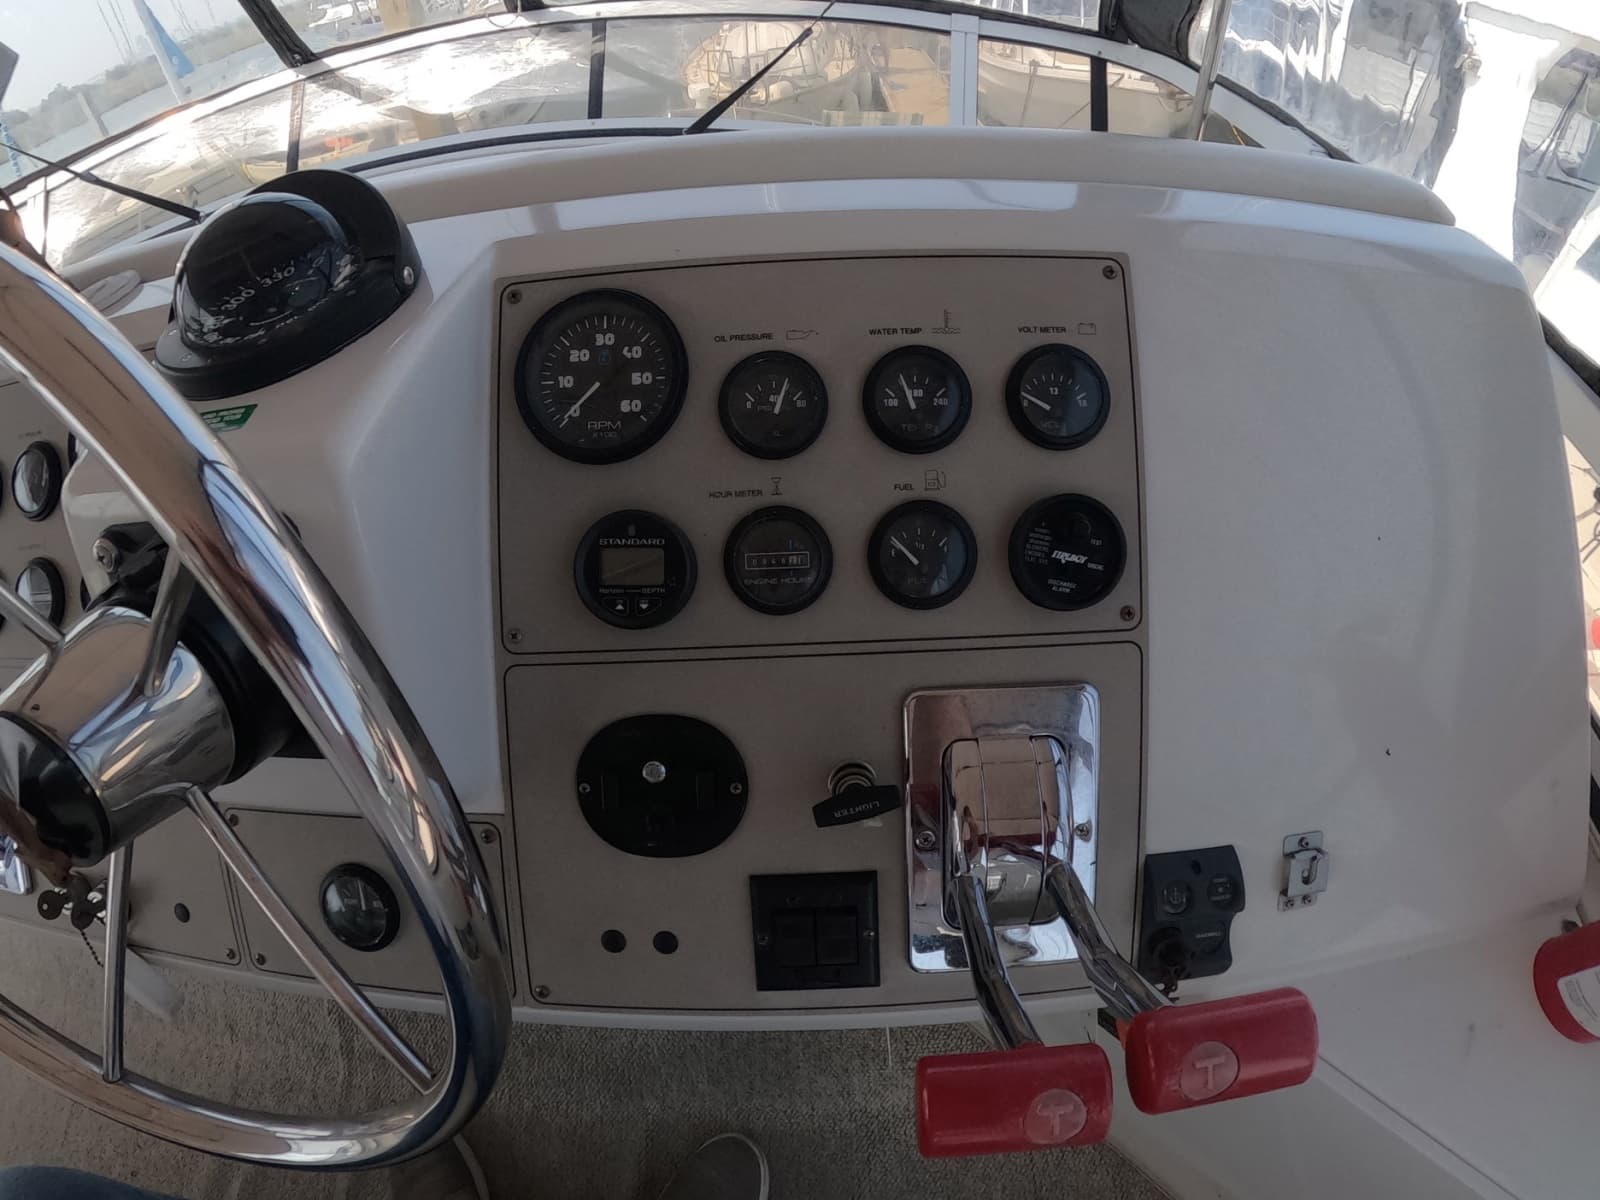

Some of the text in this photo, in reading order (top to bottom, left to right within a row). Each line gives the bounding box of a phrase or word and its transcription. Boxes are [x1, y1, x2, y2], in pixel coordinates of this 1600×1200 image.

[261, 266, 295, 288] 330
[221, 289, 255, 311] 300
[869, 327, 922, 336] WATER TEMP
[1018, 326, 1067, 334] VOLT METER
[595, 333, 615, 346] 30
[714, 332, 775, 343] OIL PRESSURE
[569, 349, 590, 362] 20
[622, 346, 643, 359] 40
[558, 375, 574, 388] 10
[631, 372, 653, 385] 50
[620, 400, 642, 413] 60
[746, 401, 752, 409] 0
[883, 398, 899, 407] 100
[933, 398, 949, 406] 240
[587, 420, 622, 431] RPM
[894, 483, 914, 491] FUEL
[709, 489, 763, 499] HOUR METER
[599, 538, 665, 546] STANDARD
[833, 800, 881, 818] LIGHTER
